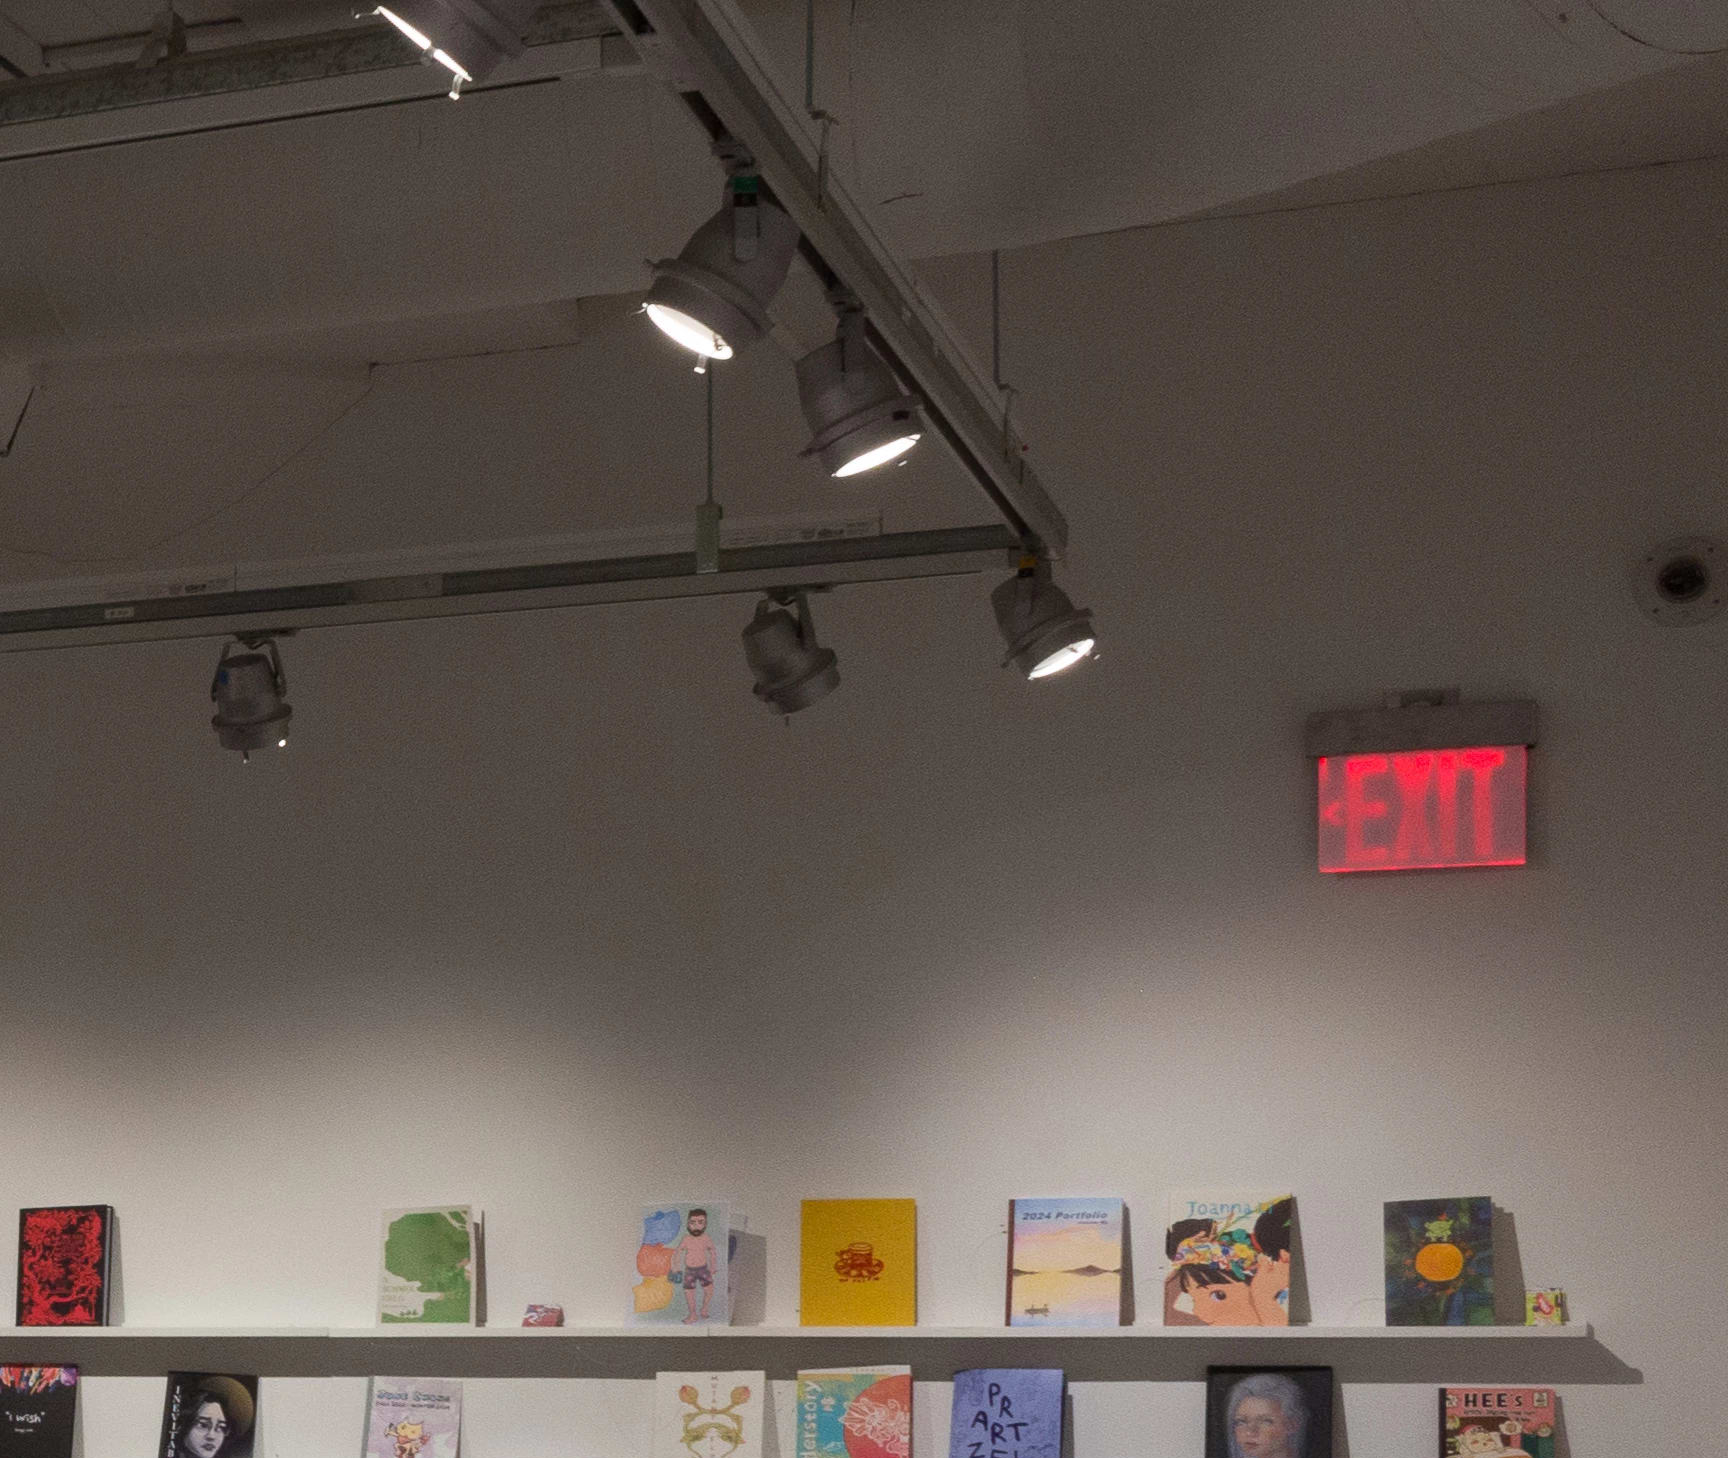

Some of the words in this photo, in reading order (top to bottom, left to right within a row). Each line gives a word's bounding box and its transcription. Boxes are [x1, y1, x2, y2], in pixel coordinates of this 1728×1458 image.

[1346, 745, 1505, 862] EXIT
[1022, 1211, 1052, 1220] 2024
[1055, 1210, 1109, 1220] Portfolio
[1185, 1200, 1254, 1217] Joanna
